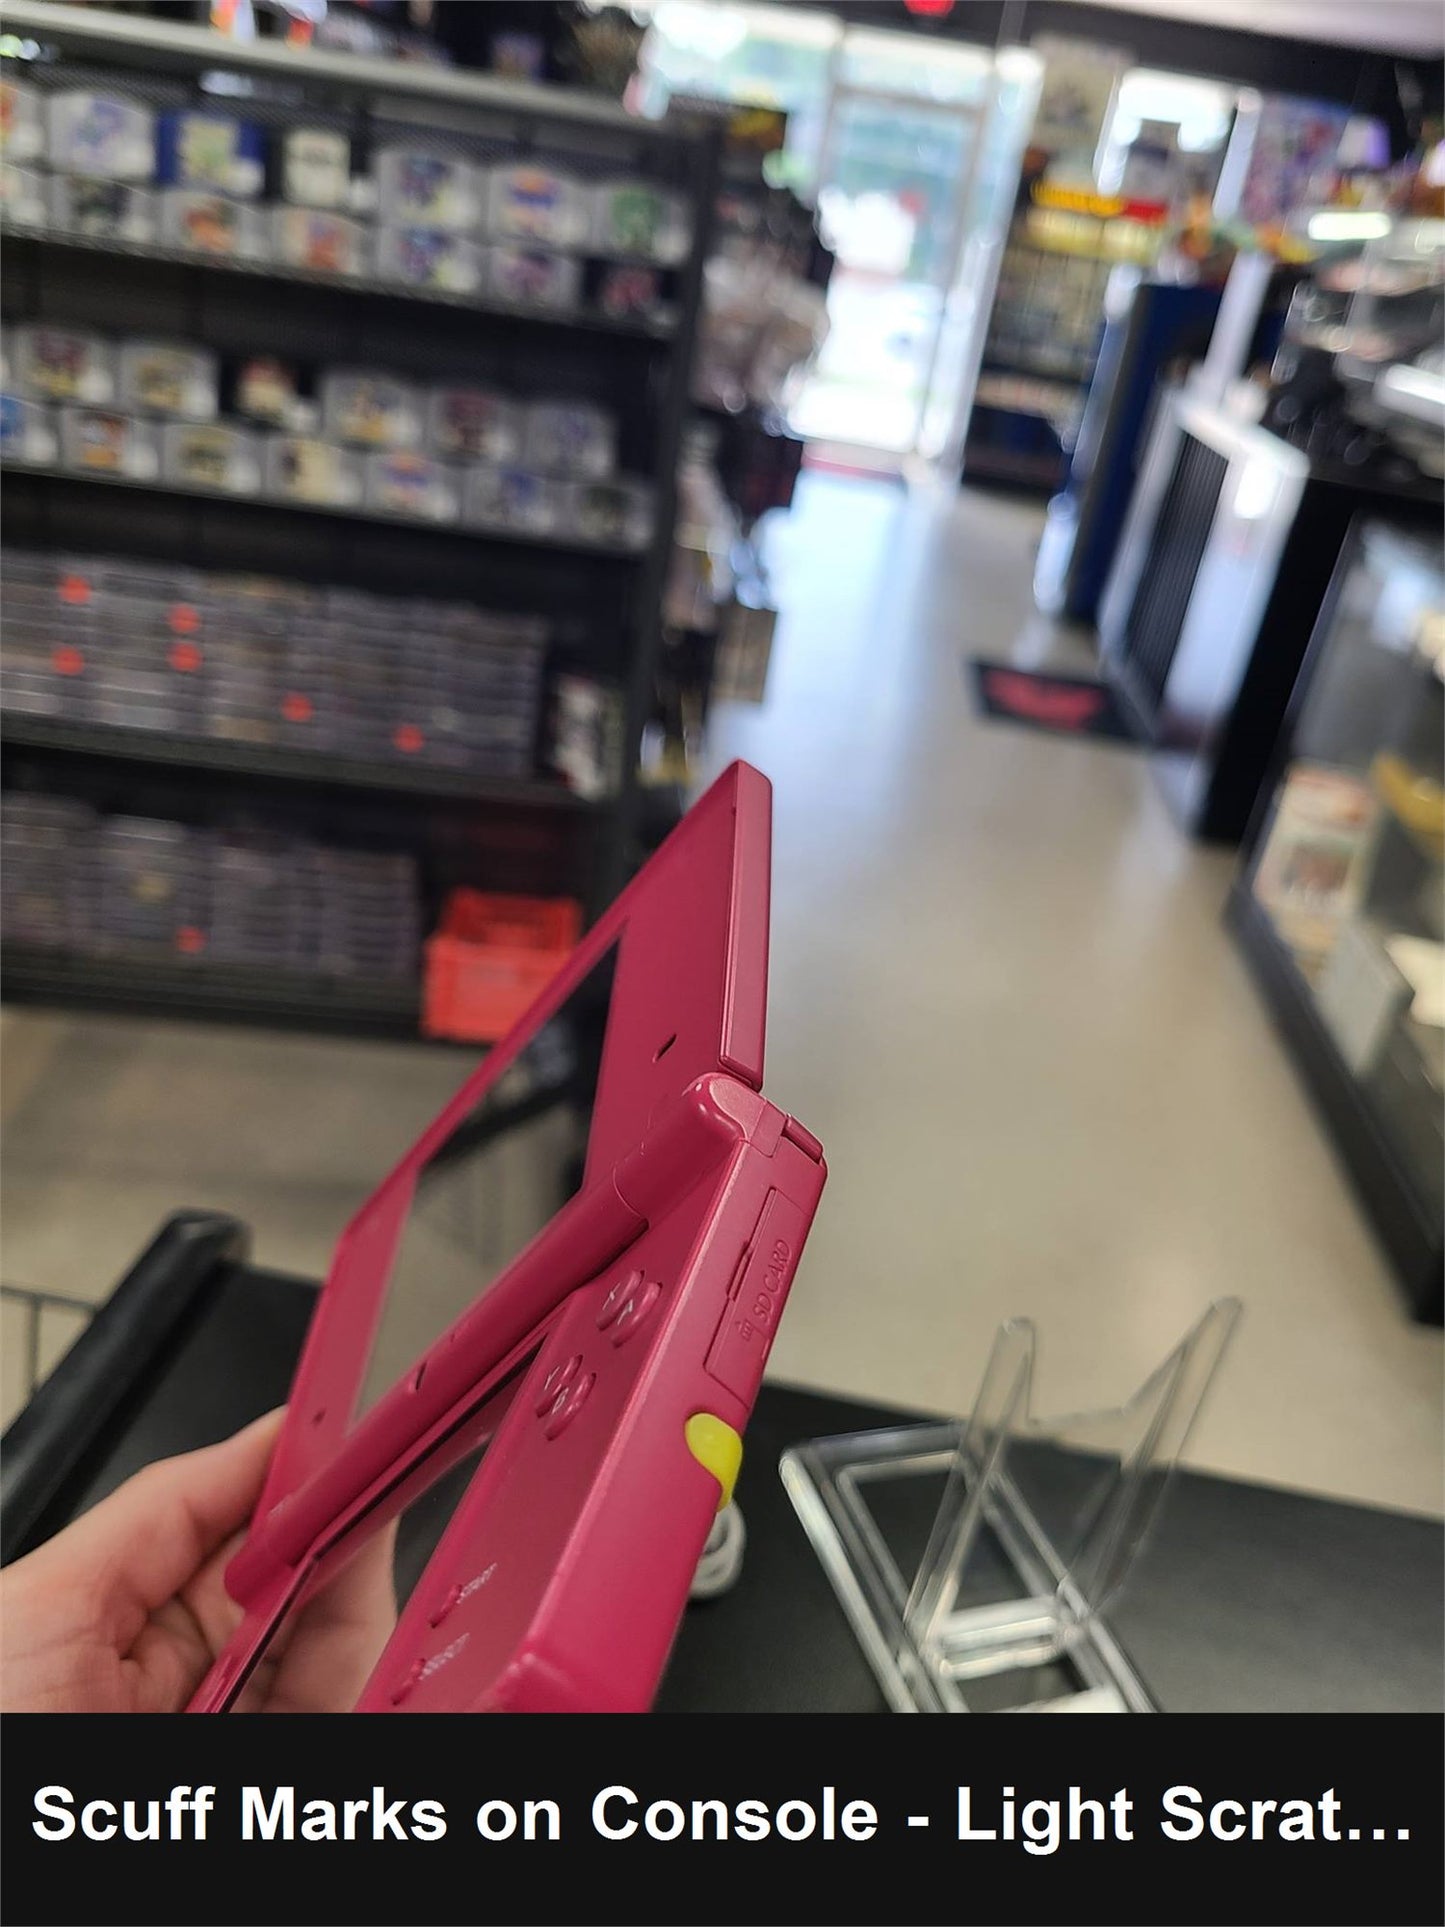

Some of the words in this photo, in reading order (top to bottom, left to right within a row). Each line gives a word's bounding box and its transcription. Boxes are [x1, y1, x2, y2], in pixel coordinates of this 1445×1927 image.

[753, 1293, 773, 1325] SD
[764, 1239, 792, 1293] CARD
[616, 1299, 634, 1325] A
[551, 1387, 569, 1414] B
